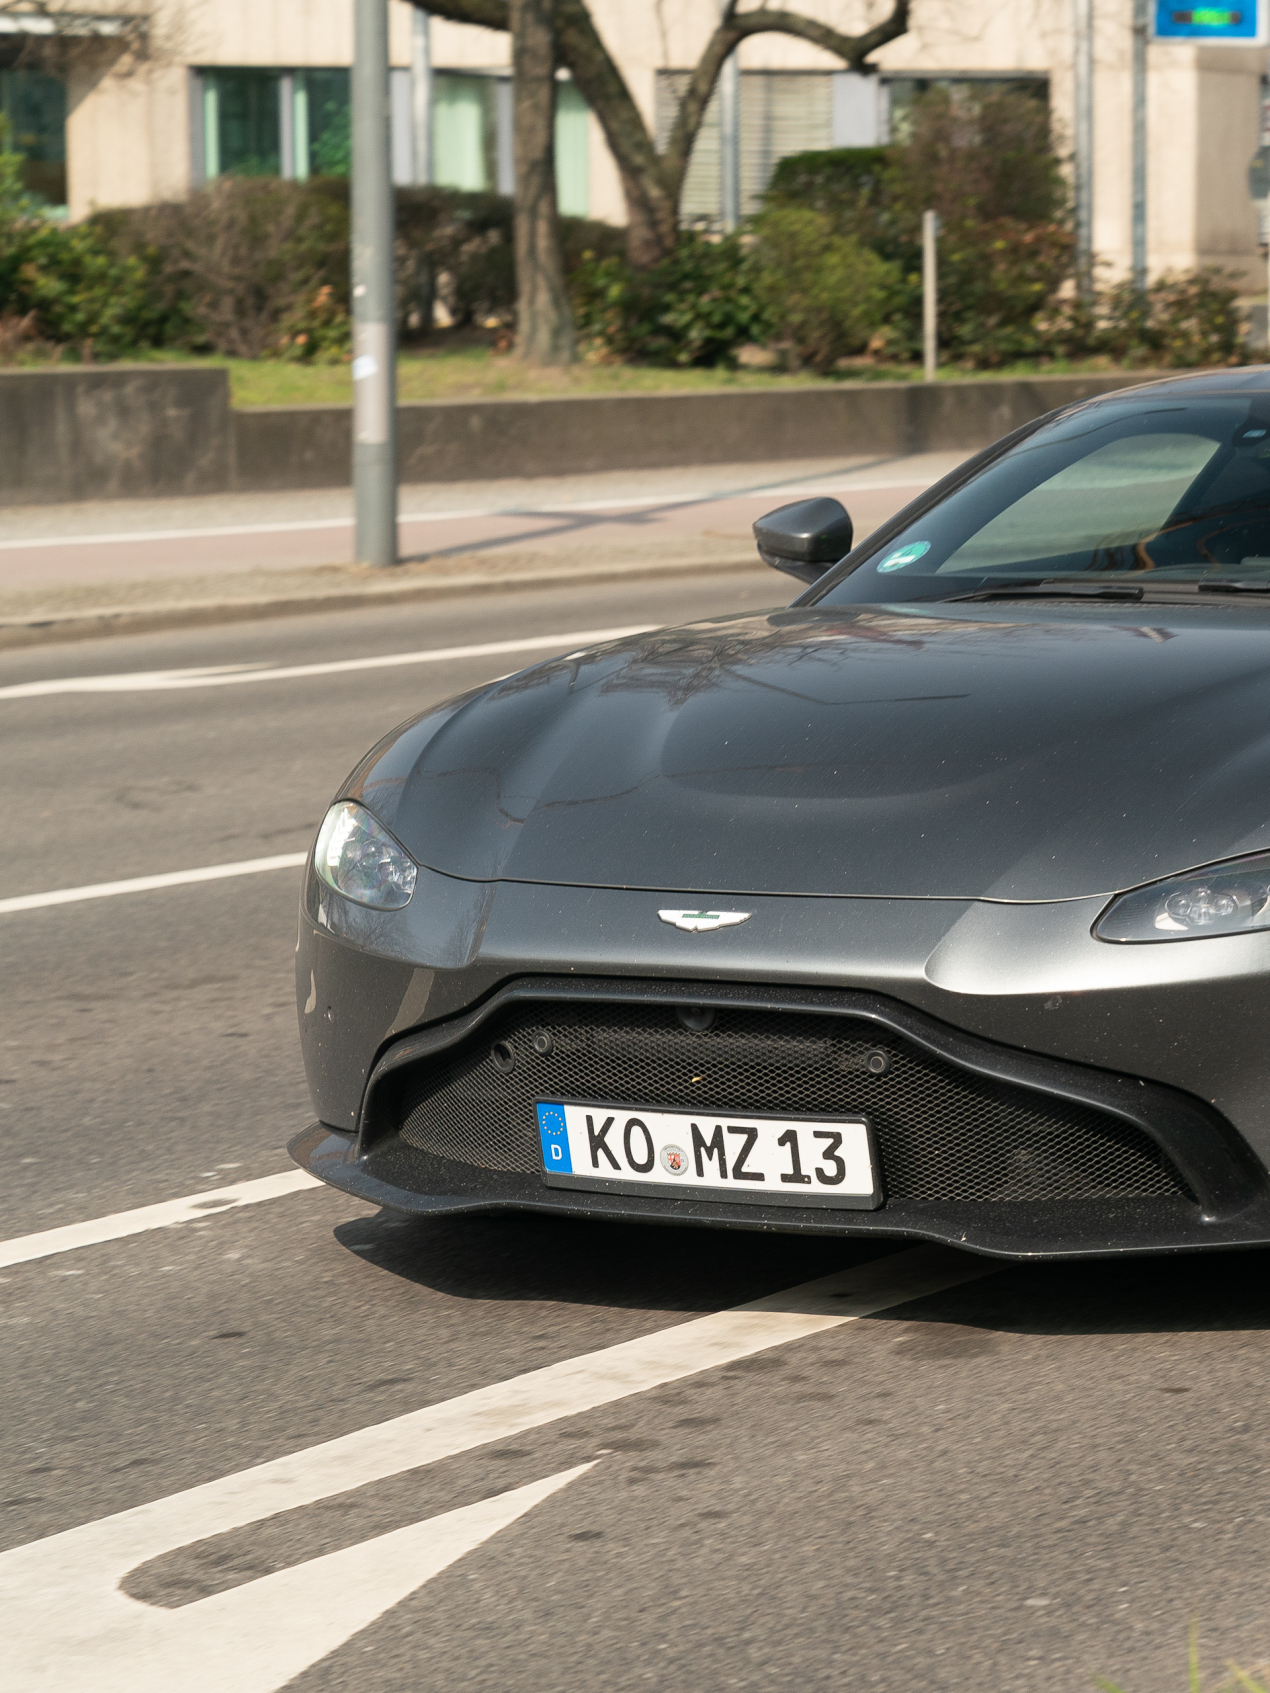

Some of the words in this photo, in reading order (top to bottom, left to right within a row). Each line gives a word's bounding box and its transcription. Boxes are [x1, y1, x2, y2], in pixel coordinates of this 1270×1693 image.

[551, 1144, 562, 1160] D
[585, 1115, 655, 1174] KO
[691, 1122, 765, 1182] MZ
[777, 1128, 847, 1186] 13
